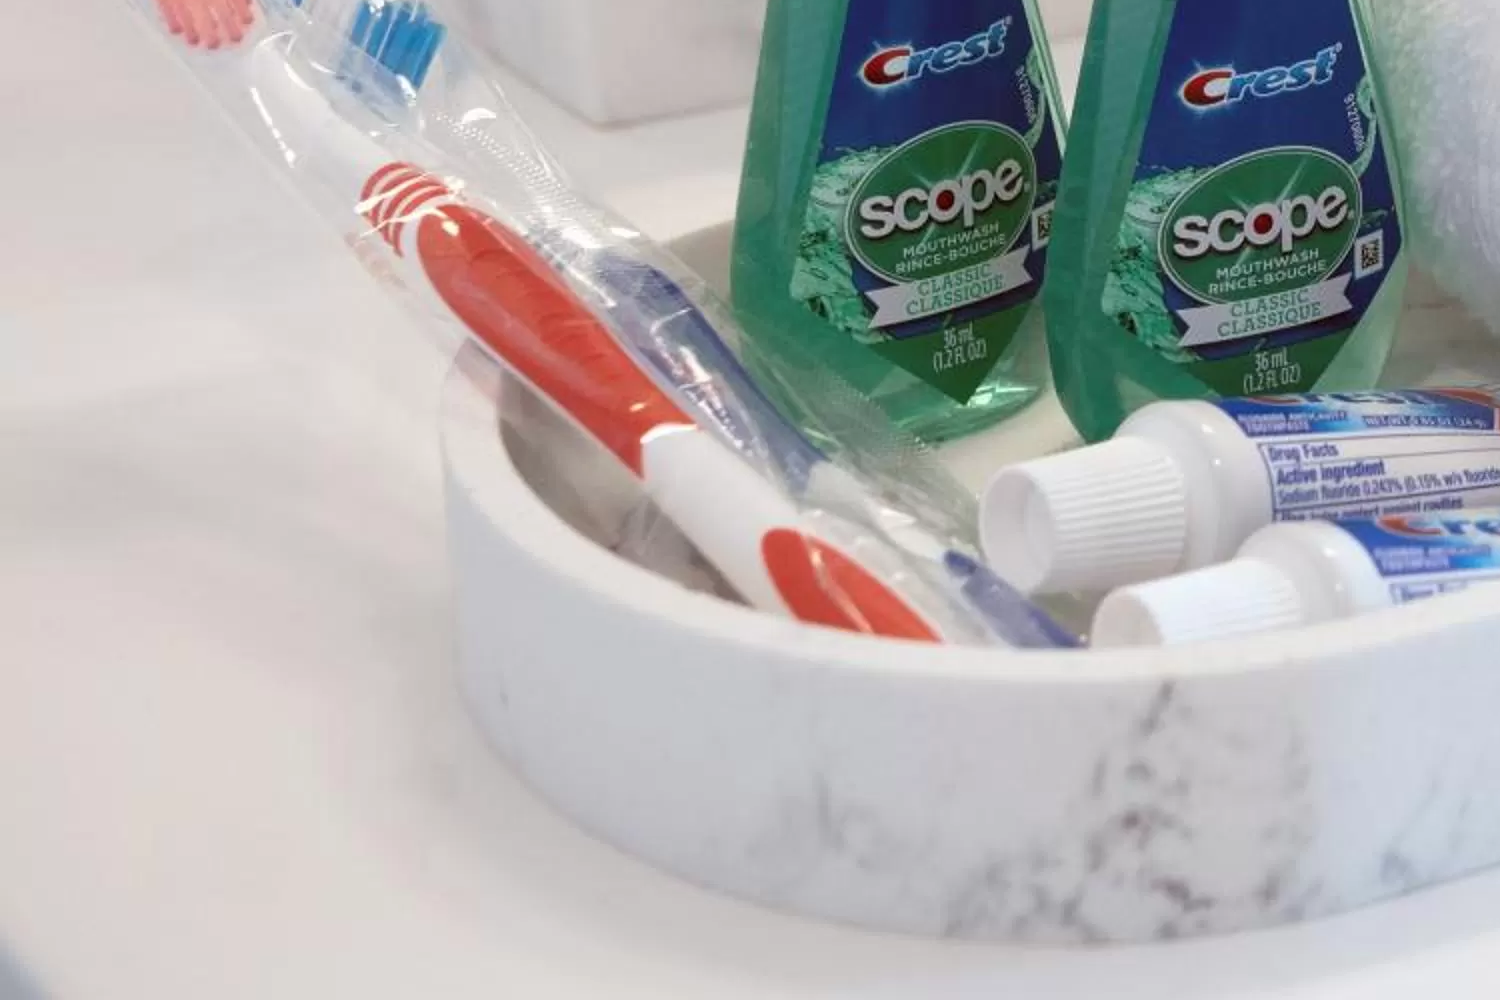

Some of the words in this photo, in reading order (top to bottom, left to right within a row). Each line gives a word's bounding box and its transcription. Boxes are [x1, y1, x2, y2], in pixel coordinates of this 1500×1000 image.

[859, 20, 1008, 88] Crest
[1180, 43, 1337, 108] Crest
[858, 158, 1024, 239] scope
[1172, 185, 1349, 258] scope
[896, 233, 1006, 274] RINCE-BOUCHE
[903, 222, 1000, 258] MOUTHWASH
[917, 263, 993, 297] CLASSIC
[1208, 260, 1327, 294] RINCE-BOUCHE
[1215, 247, 1320, 280] MOUTHWASH
[905, 275, 1005, 316] CLASSIQUE
[1230, 289, 1310, 317] CLASSIC
[1217, 302, 1321, 337] CLASSIQUE
[1255, 351, 1269, 372] 36
[1268, 446, 1299, 462] Drug
[1302, 443, 1339, 459] Facts
[1277, 466, 1318, 485] Active
[1321, 460, 1385, 482] ingredient
